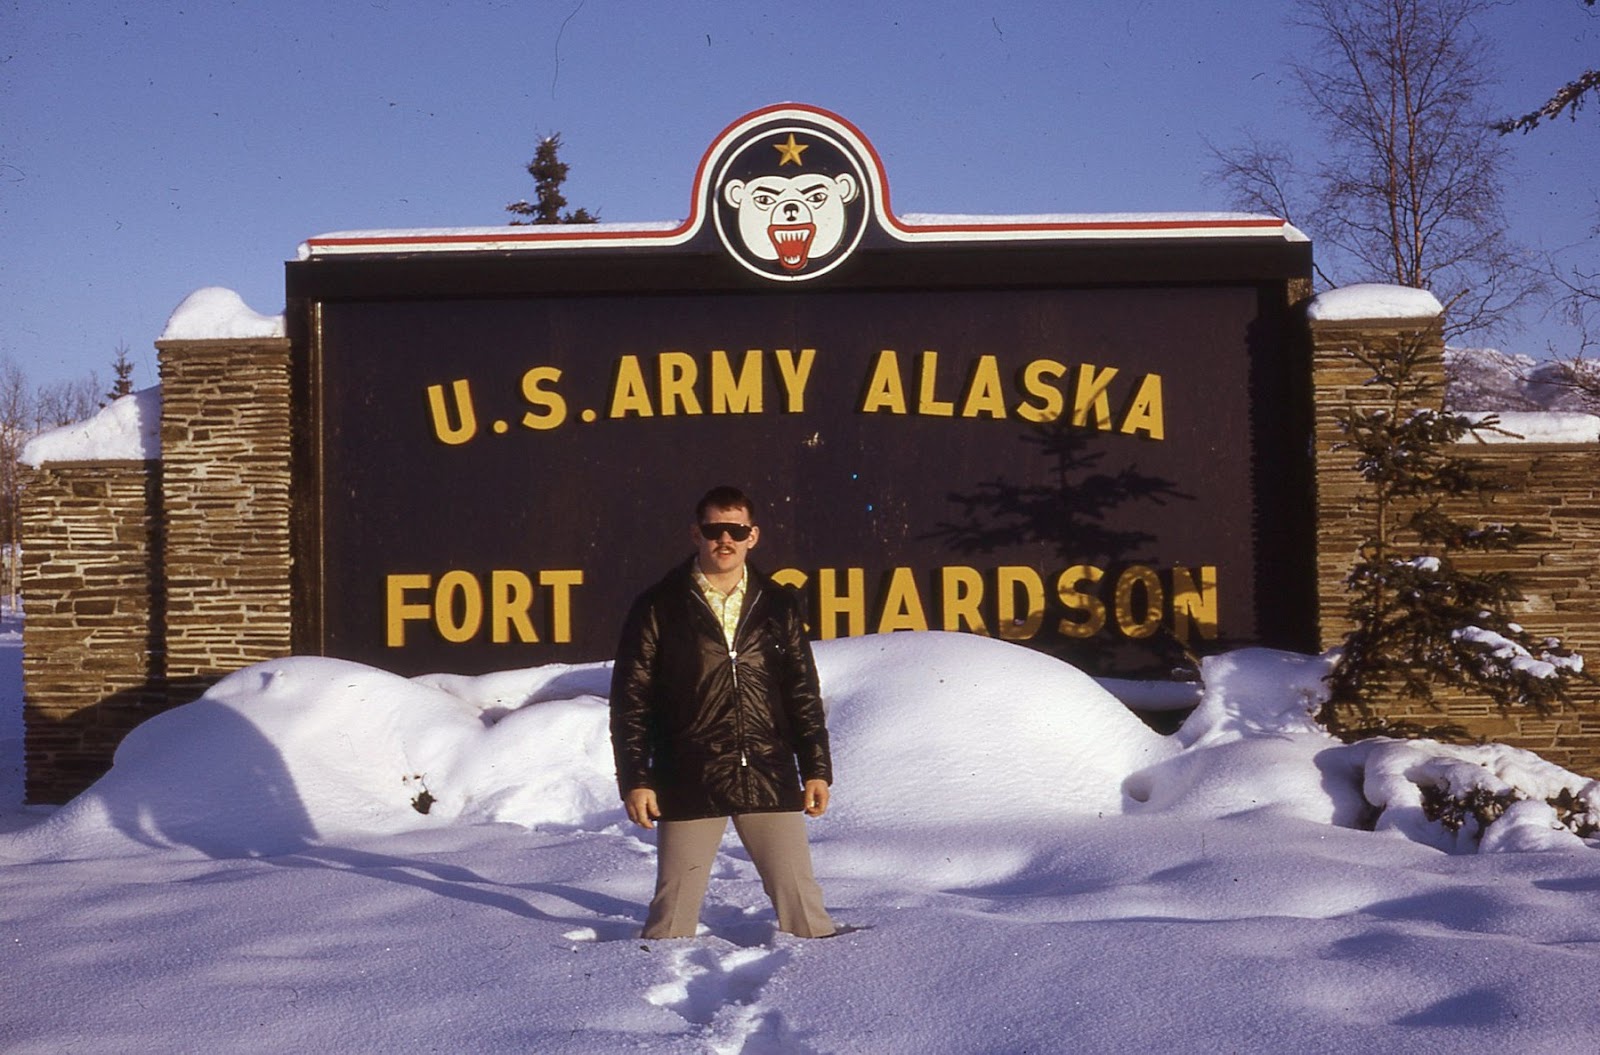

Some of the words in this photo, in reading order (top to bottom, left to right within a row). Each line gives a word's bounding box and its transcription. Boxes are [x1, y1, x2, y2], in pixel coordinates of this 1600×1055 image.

[426, 365, 597, 446] U.S.
[609, 348, 817, 420] ARMY
[862, 349, 1165, 441] ALASKA
[386, 569, 585, 648] FORT
